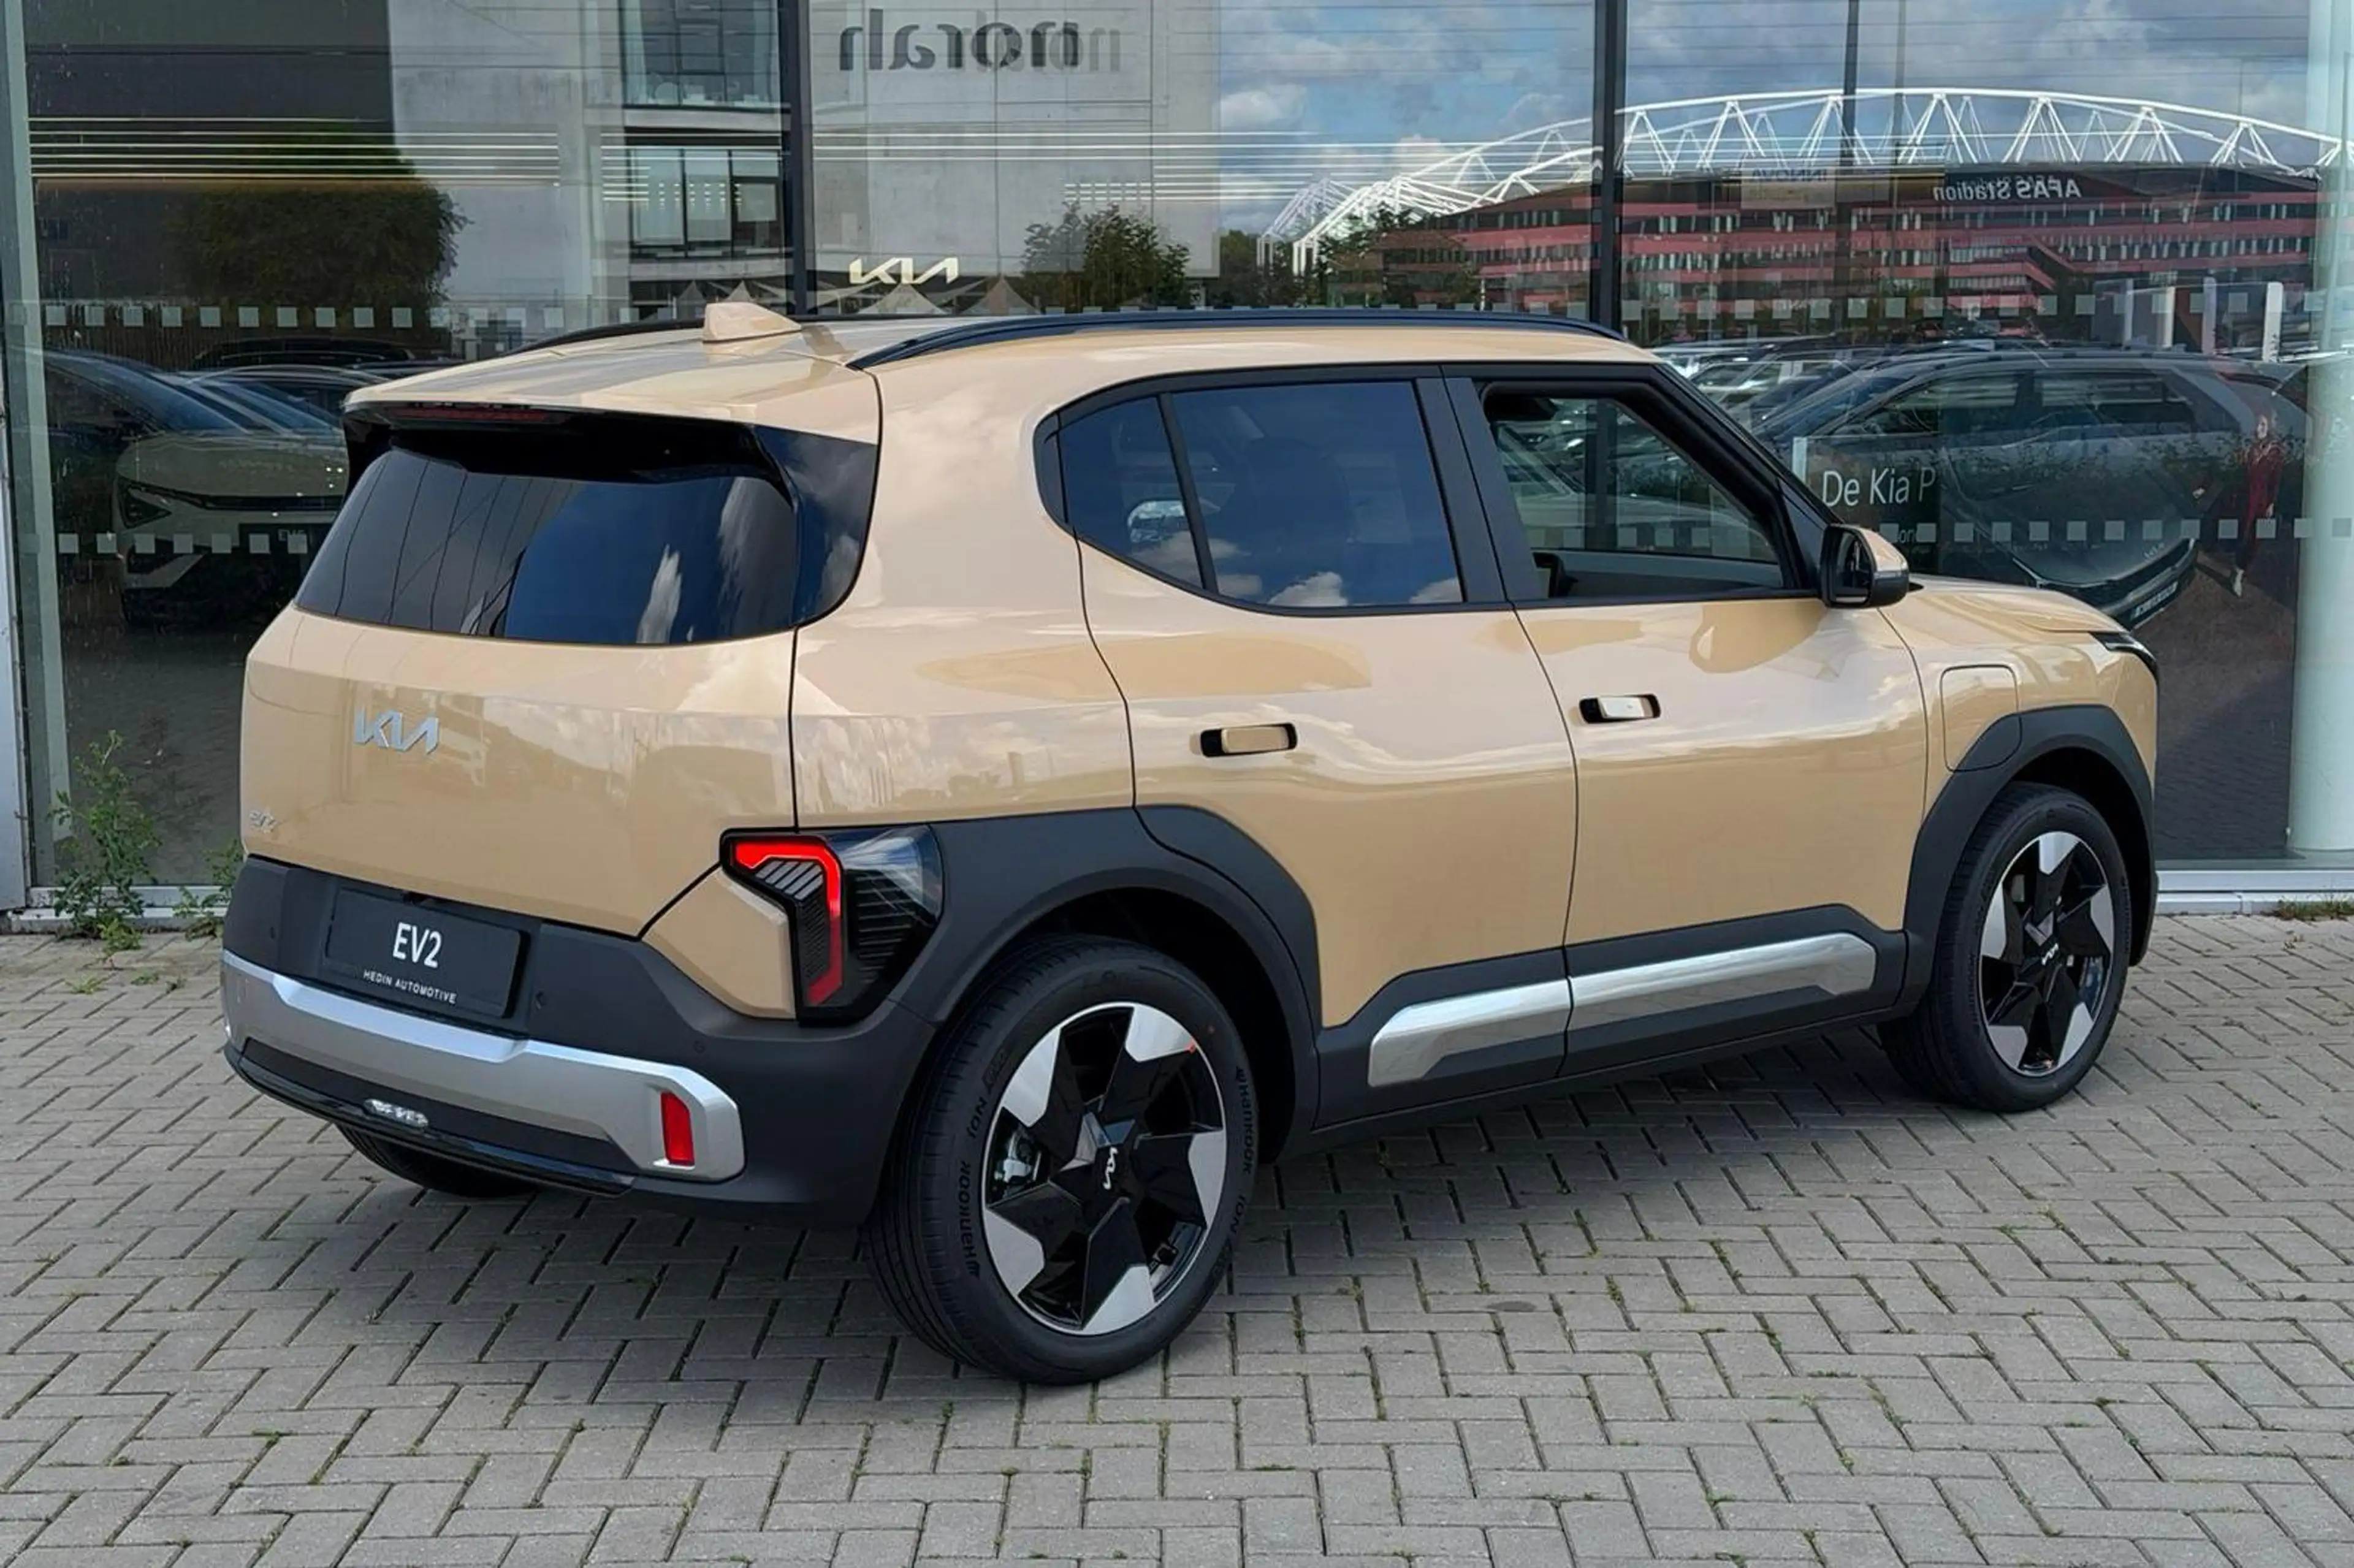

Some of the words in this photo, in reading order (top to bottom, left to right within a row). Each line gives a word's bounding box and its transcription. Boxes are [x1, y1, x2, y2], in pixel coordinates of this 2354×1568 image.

[850, 257, 959, 284] KIA
[1821, 471, 1860, 506] De
[1869, 468, 1909, 506] Kia
[353, 704, 440, 755] KIA
[392, 921, 443, 969] EV2
[363, 969, 393, 986] HEDIN
[394, 978, 458, 1005] AUTOMOTIVE
